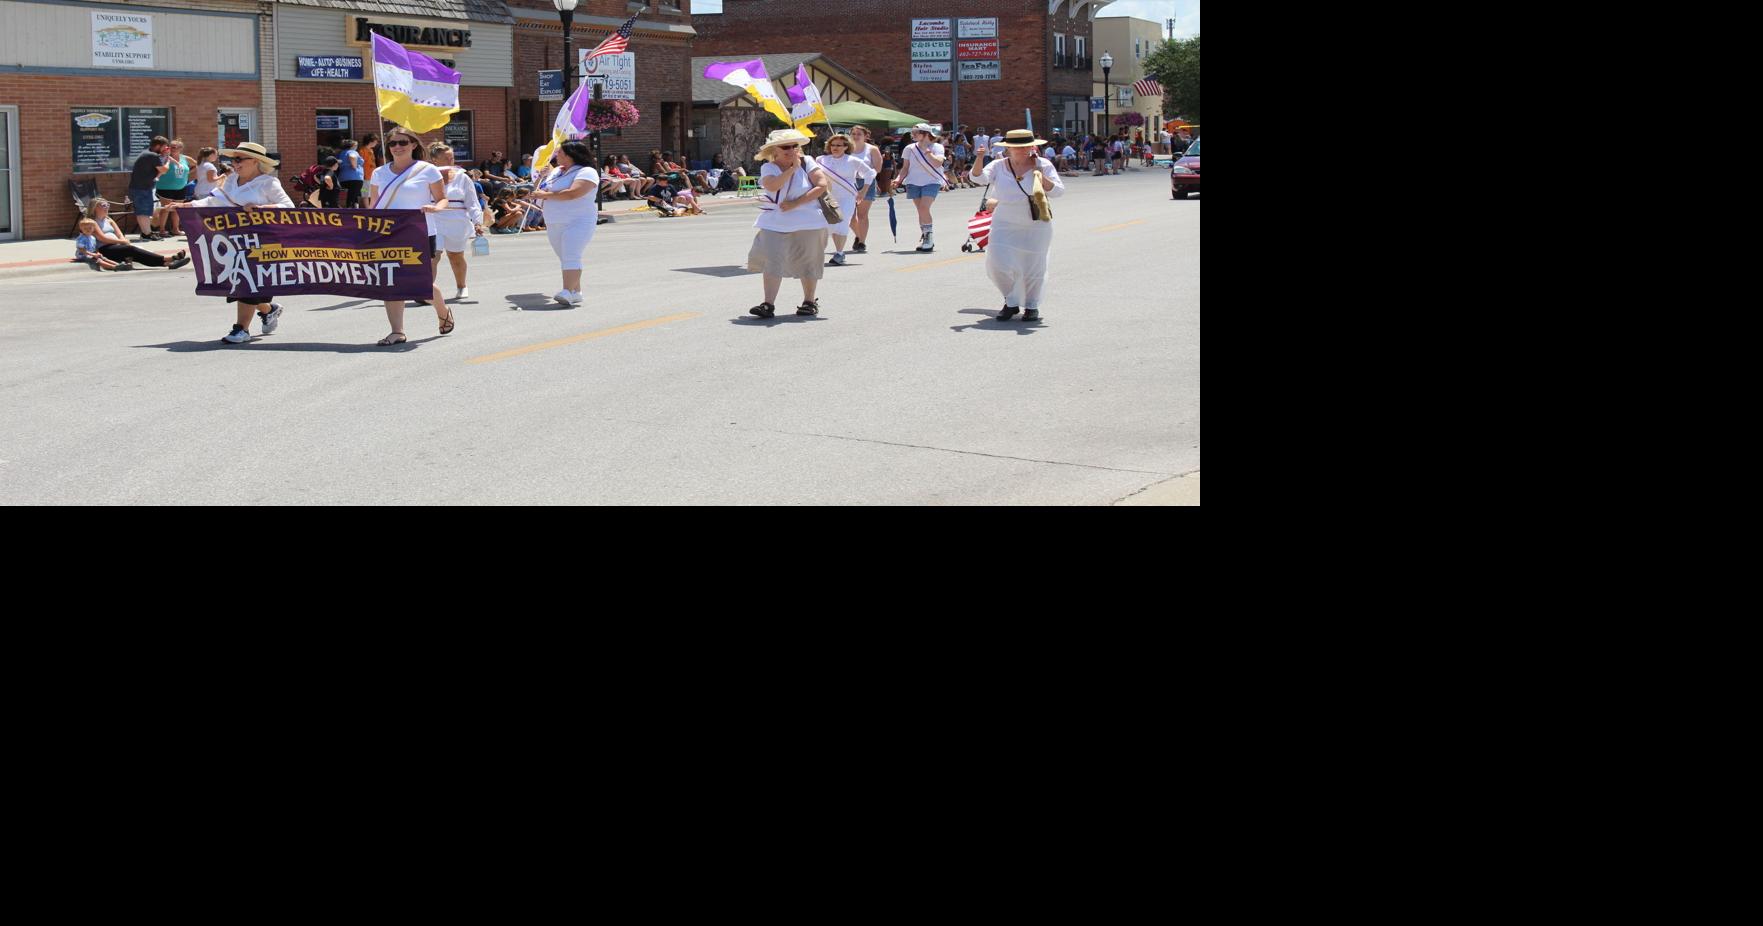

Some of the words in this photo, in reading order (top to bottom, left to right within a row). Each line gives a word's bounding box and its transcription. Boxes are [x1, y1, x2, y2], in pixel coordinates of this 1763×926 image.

[96, 14, 127, 23] UNIQUELY
[127, 16, 147, 24] YOURS
[125, 52, 151, 60] SUPPORT
[202, 210, 343, 231] CELEBRATING
[352, 215, 395, 235] THE
[194, 233, 261, 285] 19TH
[262, 250, 288, 260] HOW
[292, 249, 329, 260] WOMEN
[332, 250, 354, 260] WON
[355, 251, 376, 261] THE
[380, 249, 411, 260] VOTE
[229, 250, 401, 294] AMENDMENT
